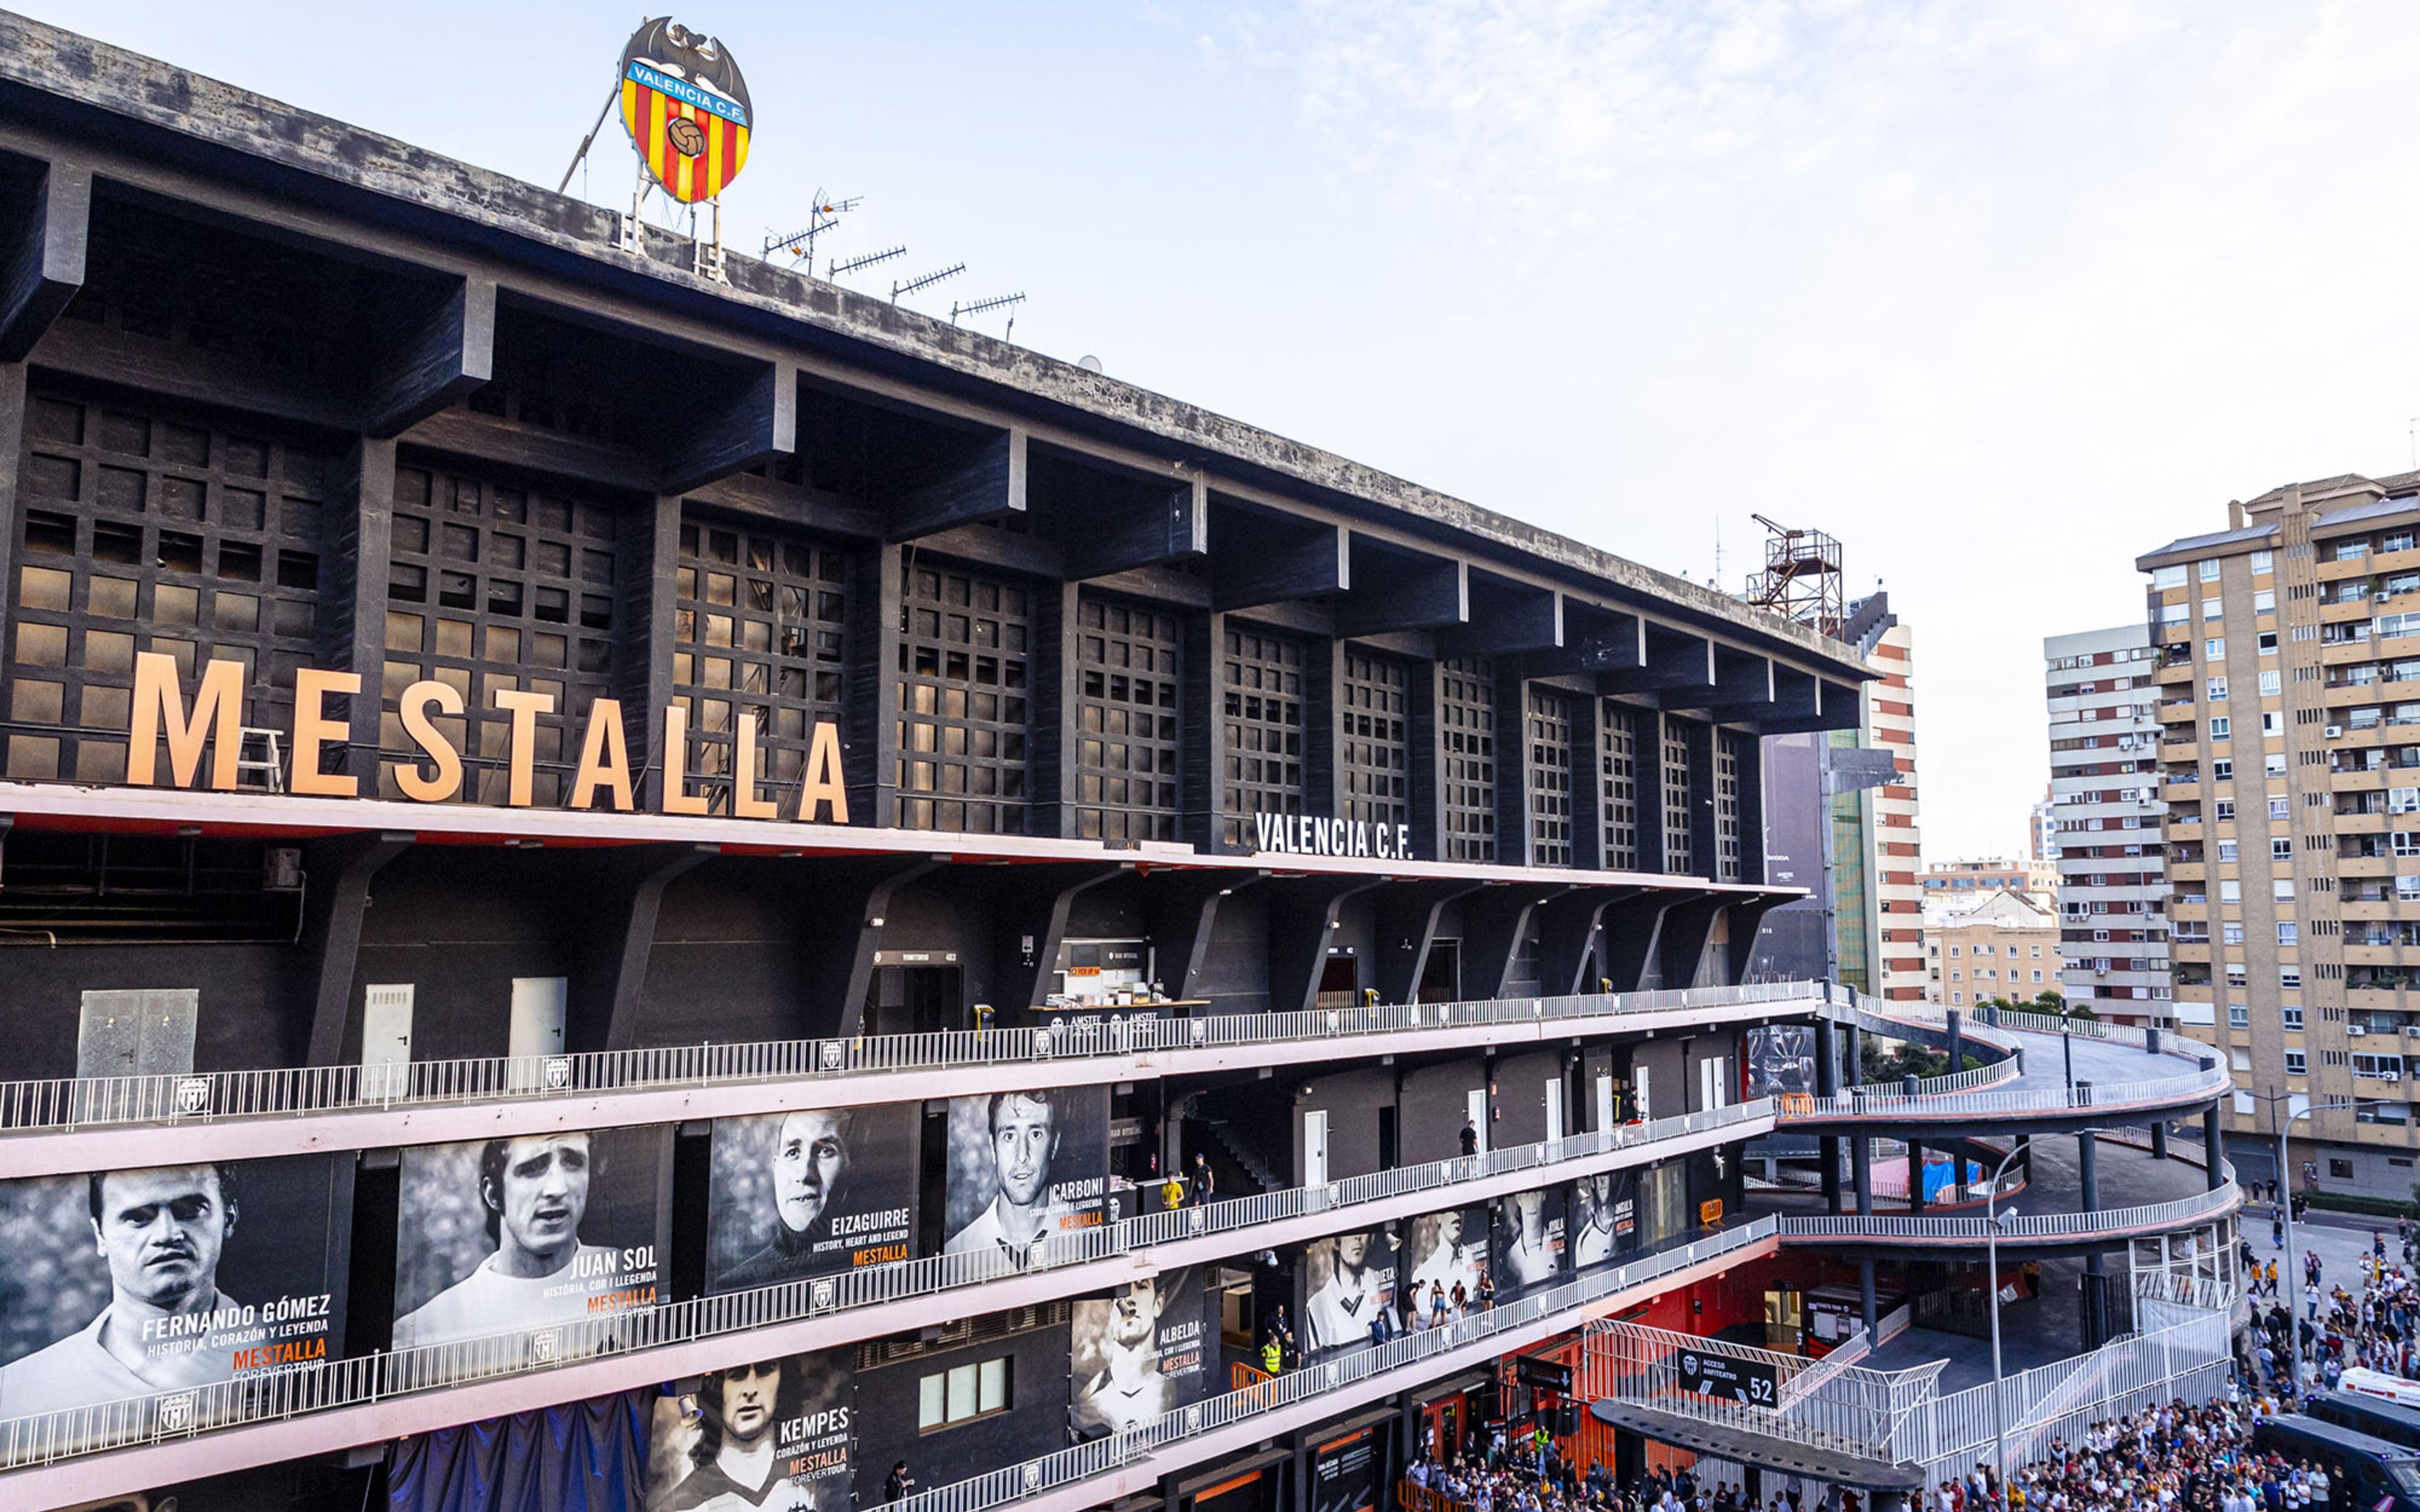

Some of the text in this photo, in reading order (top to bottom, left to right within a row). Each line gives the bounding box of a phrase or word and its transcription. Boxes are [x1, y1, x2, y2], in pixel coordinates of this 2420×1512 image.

[634, 66, 743, 121] VALENCIA C.F.
[127, 651, 849, 824] MESTALLA
[1255, 812, 1413, 860] VALENCIA C.F.
[1052, 1177, 1104, 1202] CARBONI
[831, 1208, 909, 1236] EIZAGUIRRE
[1059, 1210, 1103, 1230] MESTALLA
[813, 1230, 909, 1253] HISTORY, HEART AND LEGEND
[853, 1243, 908, 1266] MESTALLA
[569, 1245, 658, 1280] JUAN SOL
[589, 1279, 607, 1291] COR
[615, 1271, 658, 1287] LLEGENDA
[587, 1287, 657, 1314] MESTALLA
[142, 1294, 332, 1341] FERNANDO GÓMEZ
[147, 1318, 329, 1358] HISTORIA, CORAZÓN Y LEYENDA
[1160, 1320, 1200, 1345] ALBELDA
[232, 1337, 327, 1371] MESTALLA
[1162, 1350, 1200, 1372] MESTALLA
[1703, 1358, 1726, 1370] ACCESO
[1703, 1368, 1737, 1381] ANFITEATRO
[1750, 1377, 1772, 1402] 52
[780, 1406, 849, 1444] KEMPES
[776, 1432, 848, 1459] CORAZÓN Y LEYENDA
[790, 1447, 847, 1477] MESTALLA
[790, 1463, 847, 1485] FOREVERTOUR
